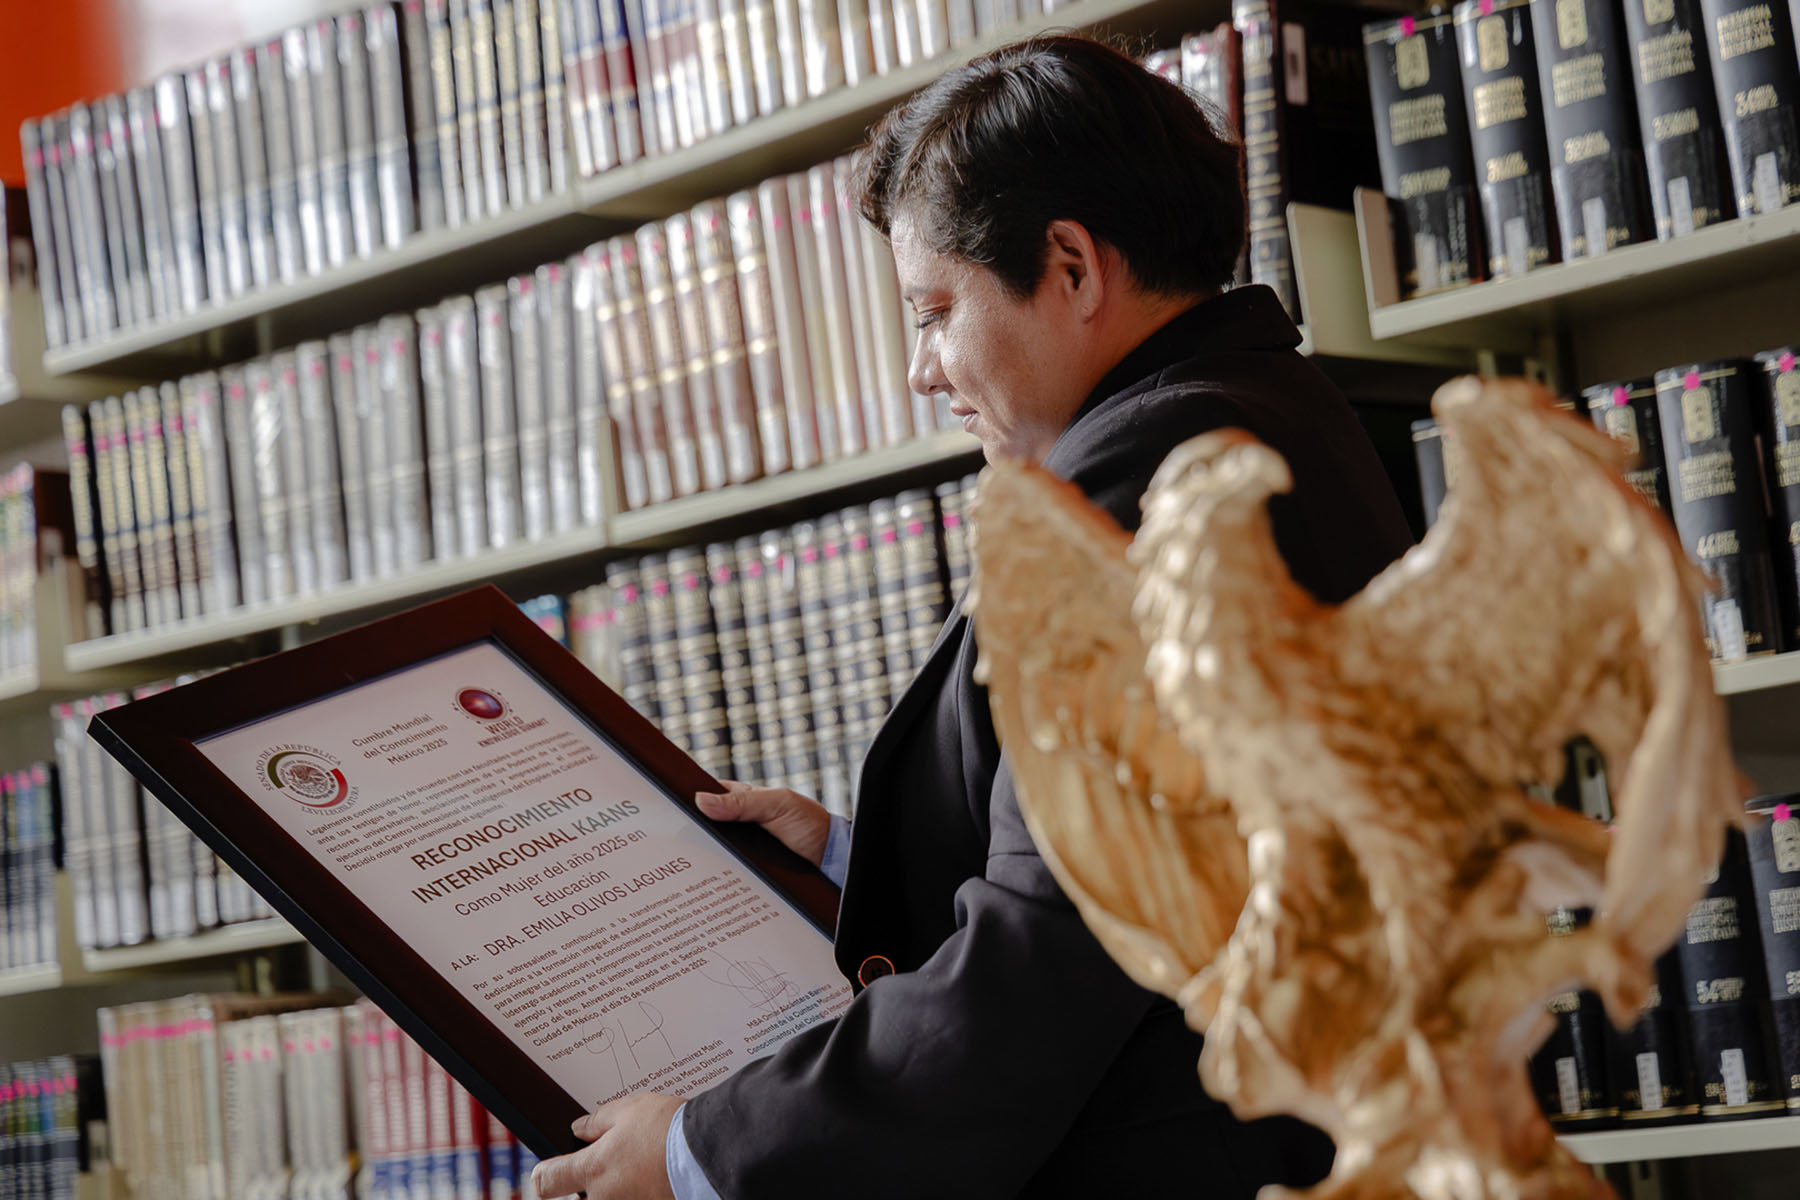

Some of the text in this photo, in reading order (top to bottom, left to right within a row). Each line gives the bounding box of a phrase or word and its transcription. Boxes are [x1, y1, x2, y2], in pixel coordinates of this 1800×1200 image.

[351, 713, 433, 747] Cumbre Mundial
[362, 724, 448, 759] del Conocimiento
[386, 738, 448, 765] México 2025
[477, 728, 521, 748] KNOWLEDGE
[484, 716, 524, 735] WORLD
[256, 759, 273, 791] SENADO
[270, 744, 283, 754] LA
[306, 815, 354, 836] Legalmente
[352, 796, 402, 818] constituidos
[416, 778, 448, 793] acuerdo
[446, 772, 463, 781] con
[459, 768, 474, 776] las
[471, 753, 511, 771] facultades
[316, 835, 336, 845] ante
[335, 828, 351, 837] los
[351, 815, 385, 831] testigos
[397, 799, 425, 812] honor,
[425, 777, 481, 801] representantes
[321, 785, 360, 816] LEGISLATURA
[325, 793, 470, 854] rectores universitarios, asociaciones
[335, 787, 514, 863] ejecutivo del Centro Internacional de Inteligencia
[343, 819, 463, 872] Decidió otorgar por unanimidad
[410, 788, 593, 870] RECONOCIMIENTO
[411, 799, 641, 904] INTERNACIONAL KAANS
[454, 829, 648, 916] Como Mujer del año 2025 en
[483, 857, 692, 956] DRA. EMILIA OLIVOS LAGUNES
[532, 869, 611, 908] Educación
[472, 981, 489, 991] Por
[491, 974, 504, 982] su
[506, 949, 558, 975] sobresaliente
[560, 926, 607, 951] contribución
[628, 892, 683, 918] transformación
[684, 875, 721, 893] educativa,
[483, 977, 528, 1000] dedicación
[541, 951, 582, 973] formación
[579, 937, 610, 954] integral
[608, 933, 621, 941] de
[619, 914, 662, 936] estudiantes
[675, 890, 715, 910] incansable
[712, 877, 742, 892] impulso
[493, 997, 514, 1011] para
[510, 983, 542, 1001] integrar
[539, 979, 551, 987] la
[547, 960, 591, 984] innovación
[594, 953, 605, 961] el
[602, 932, 652, 958] conocimiento
[650, 927, 662, 935] en
[658, 912, 694, 931] beneficio
[691, 908, 703, 916] de
[708, 890, 742, 908] sociedad.
[502, 998, 540, 1019] liderazgo
[538, 979, 581, 1002] académico
[585, 971, 597, 980] su
[595, 950, 641, 975] compromiso
[639, 943, 656, 954] con
[661, 922, 700, 943] excelencia
[705, 903, 742, 922] distinguen
[740, 894, 761, 906] como
[450, 953, 480, 971] A LA:
[513, 1009, 547, 1028] ejemplo
[552, 990, 588, 1009] referente
[587, 984, 599, 992] en
[598, 978, 609, 987] el
[606, 967, 635, 983] ámbito
[633, 950, 670, 970] educativo
[668, 934, 701, 953] nacional
[704, 910, 752, 936] internacional.
[523, 1021, 550, 1038] marco
[550, 1013, 565, 1024] del
[563, 1007, 581, 1017] 6to.
[580, 985, 626, 1009] Aniversario,
[625, 968, 660, 988] realizada
[659, 963, 671, 971] en
[670, 958, 680, 966] el
[678, 945, 708, 961] Senado
[706, 940, 718, 948] de
[725, 919, 761, 939] República
[532, 957, 710, 1047] Ciudad de México, el día 25 de septiembre de 2025.
[743, 1023, 780, 1043] Presidente
[792, 1002, 819, 1018] Cumbre
[546, 1040, 585, 1062] Testigo de
[746, 1009, 830, 1055] Conocimiento del Colegio
[627, 1077, 651, 1092] Jorge
[647, 1065, 675, 1081] Carlos
[700, 1039, 724, 1054] Marín
[663, 1048, 734, 1088] de la Mesa Directiva
[674, 1088, 686, 1098] de
[682, 1084, 694, 1092] la
[690, 1065, 730, 1087] República
